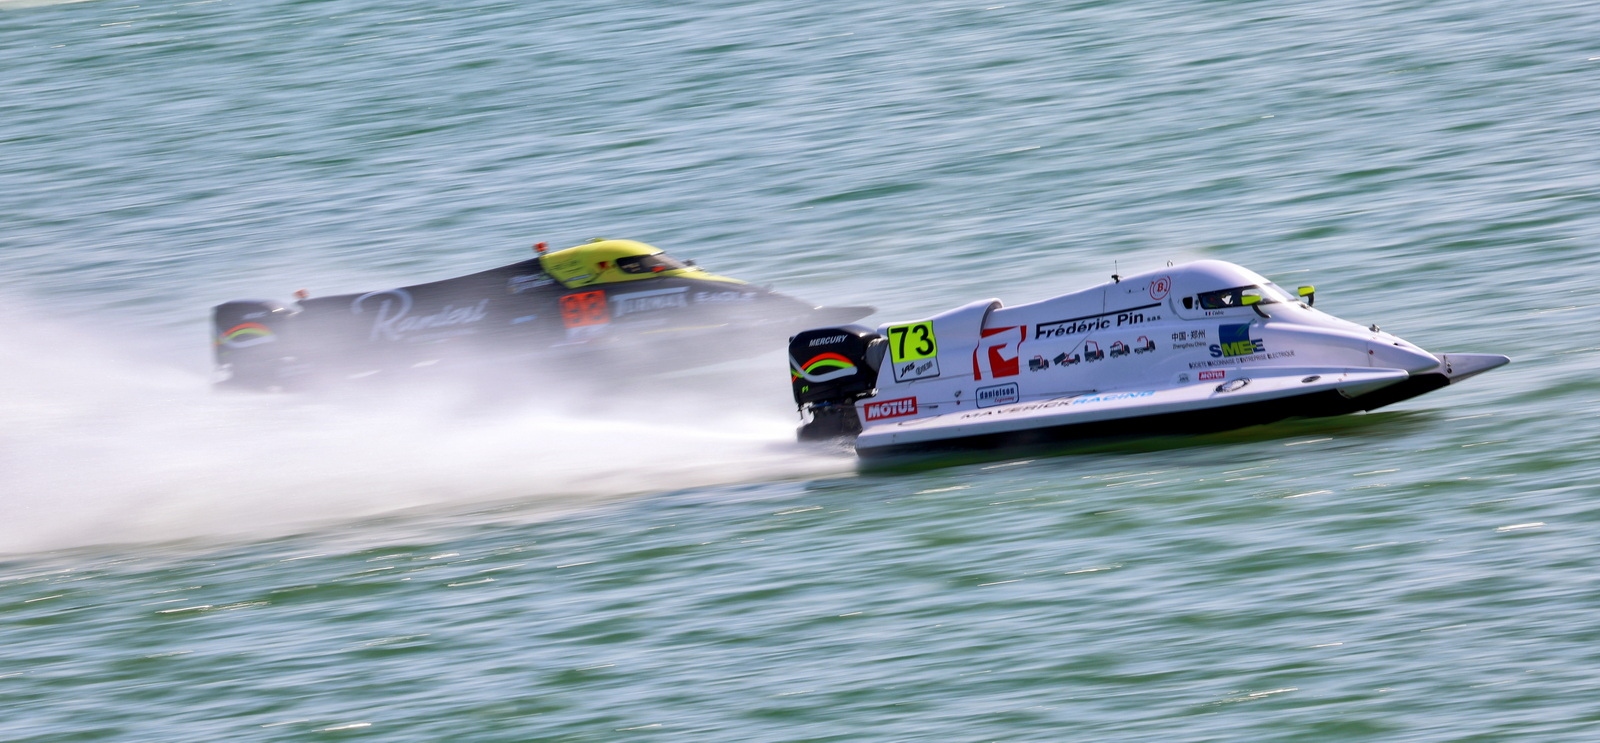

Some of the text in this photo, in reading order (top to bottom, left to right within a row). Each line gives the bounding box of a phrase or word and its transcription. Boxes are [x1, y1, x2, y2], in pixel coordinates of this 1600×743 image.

[1035, 318, 1110, 339] Frédéric
[1117, 311, 1144, 326] Pin
[808, 334, 848, 347] MERCURY
[890, 324, 935, 359] 73
[1200, 371, 1224, 380] MOTUL
[980, 387, 1015, 400] danielson
[867, 397, 915, 418] MOTUL
